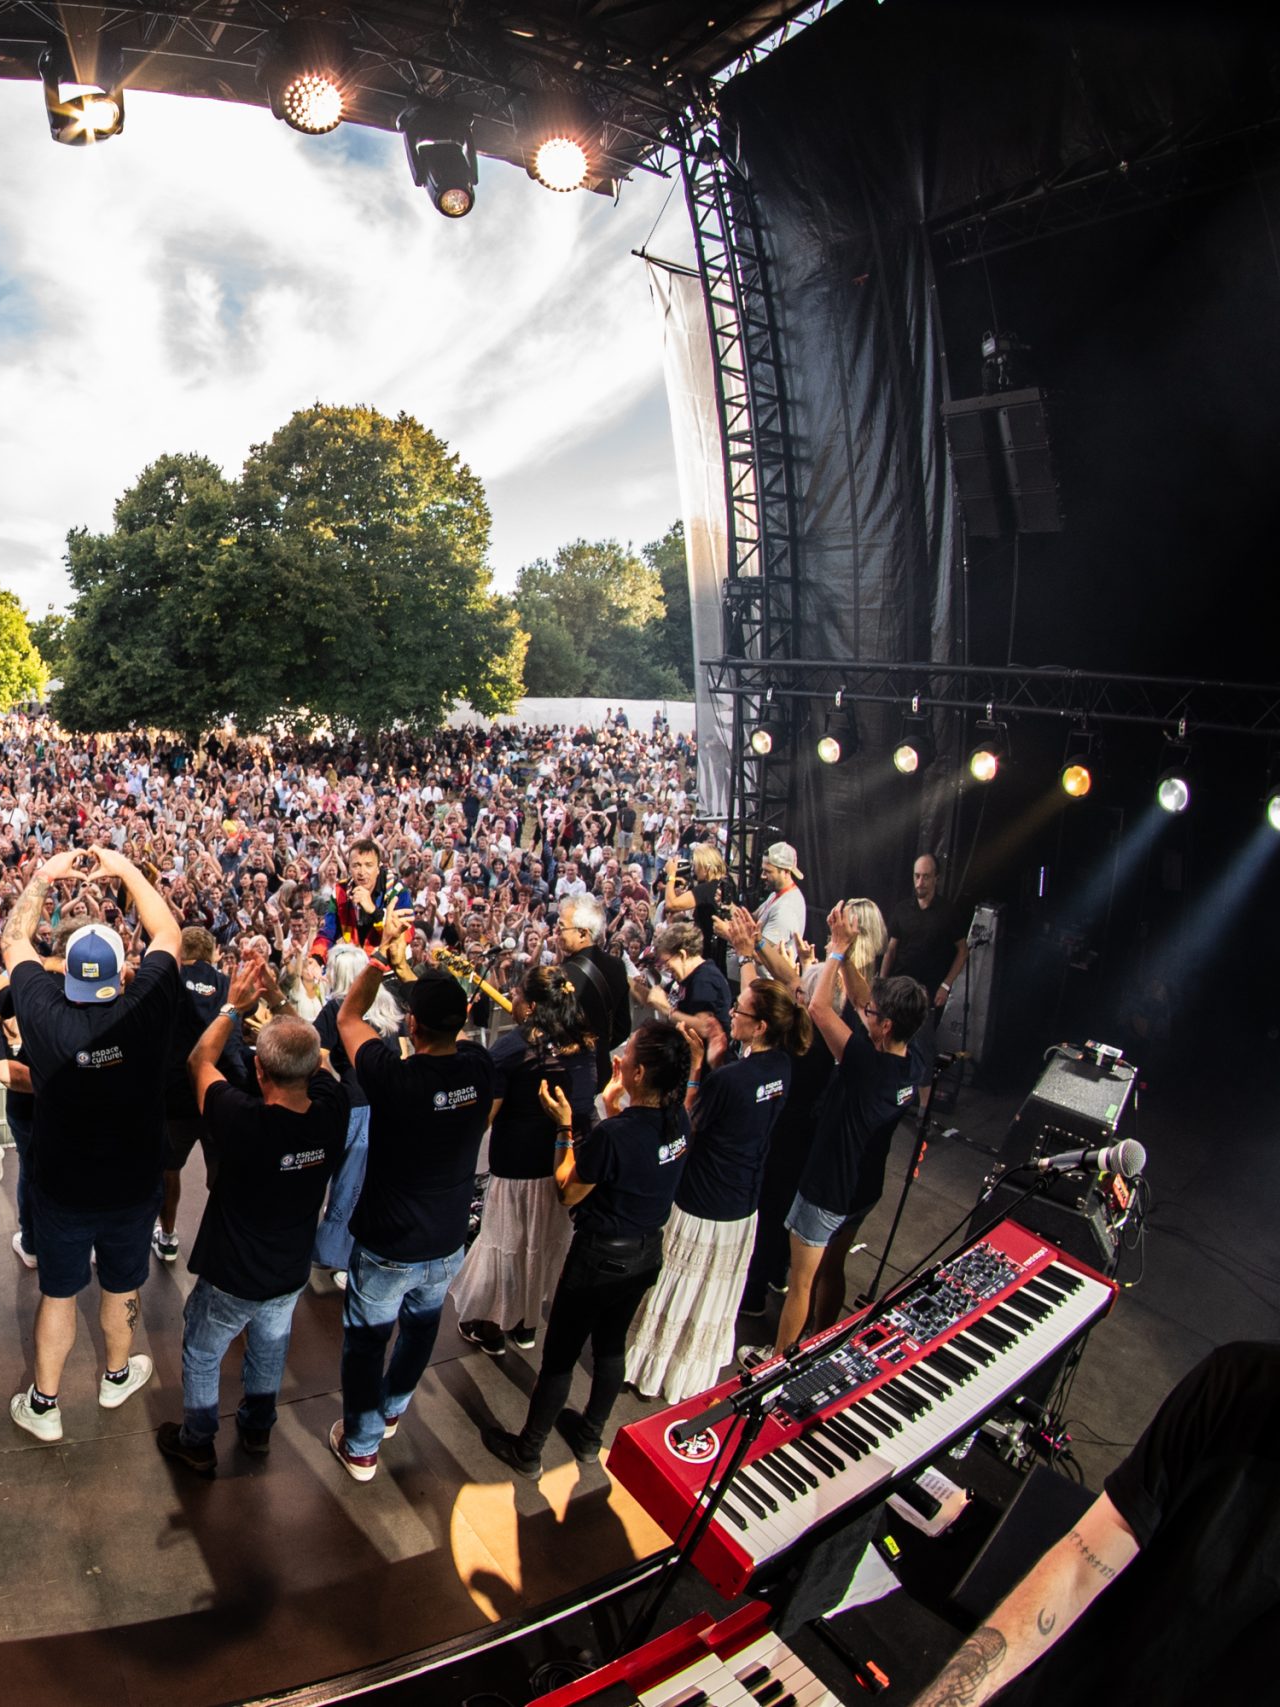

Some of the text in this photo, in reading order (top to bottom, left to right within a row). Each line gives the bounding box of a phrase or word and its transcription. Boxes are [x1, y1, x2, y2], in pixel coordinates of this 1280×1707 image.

[91, 1046, 119, 1057] espace
[91, 1050, 123, 1064] culturel
[448, 1086, 474, 1098] espace
[448, 1091, 478, 1104] culturel
[295, 1153, 326, 1164] culturel
[296, 1149, 324, 1159] espace
